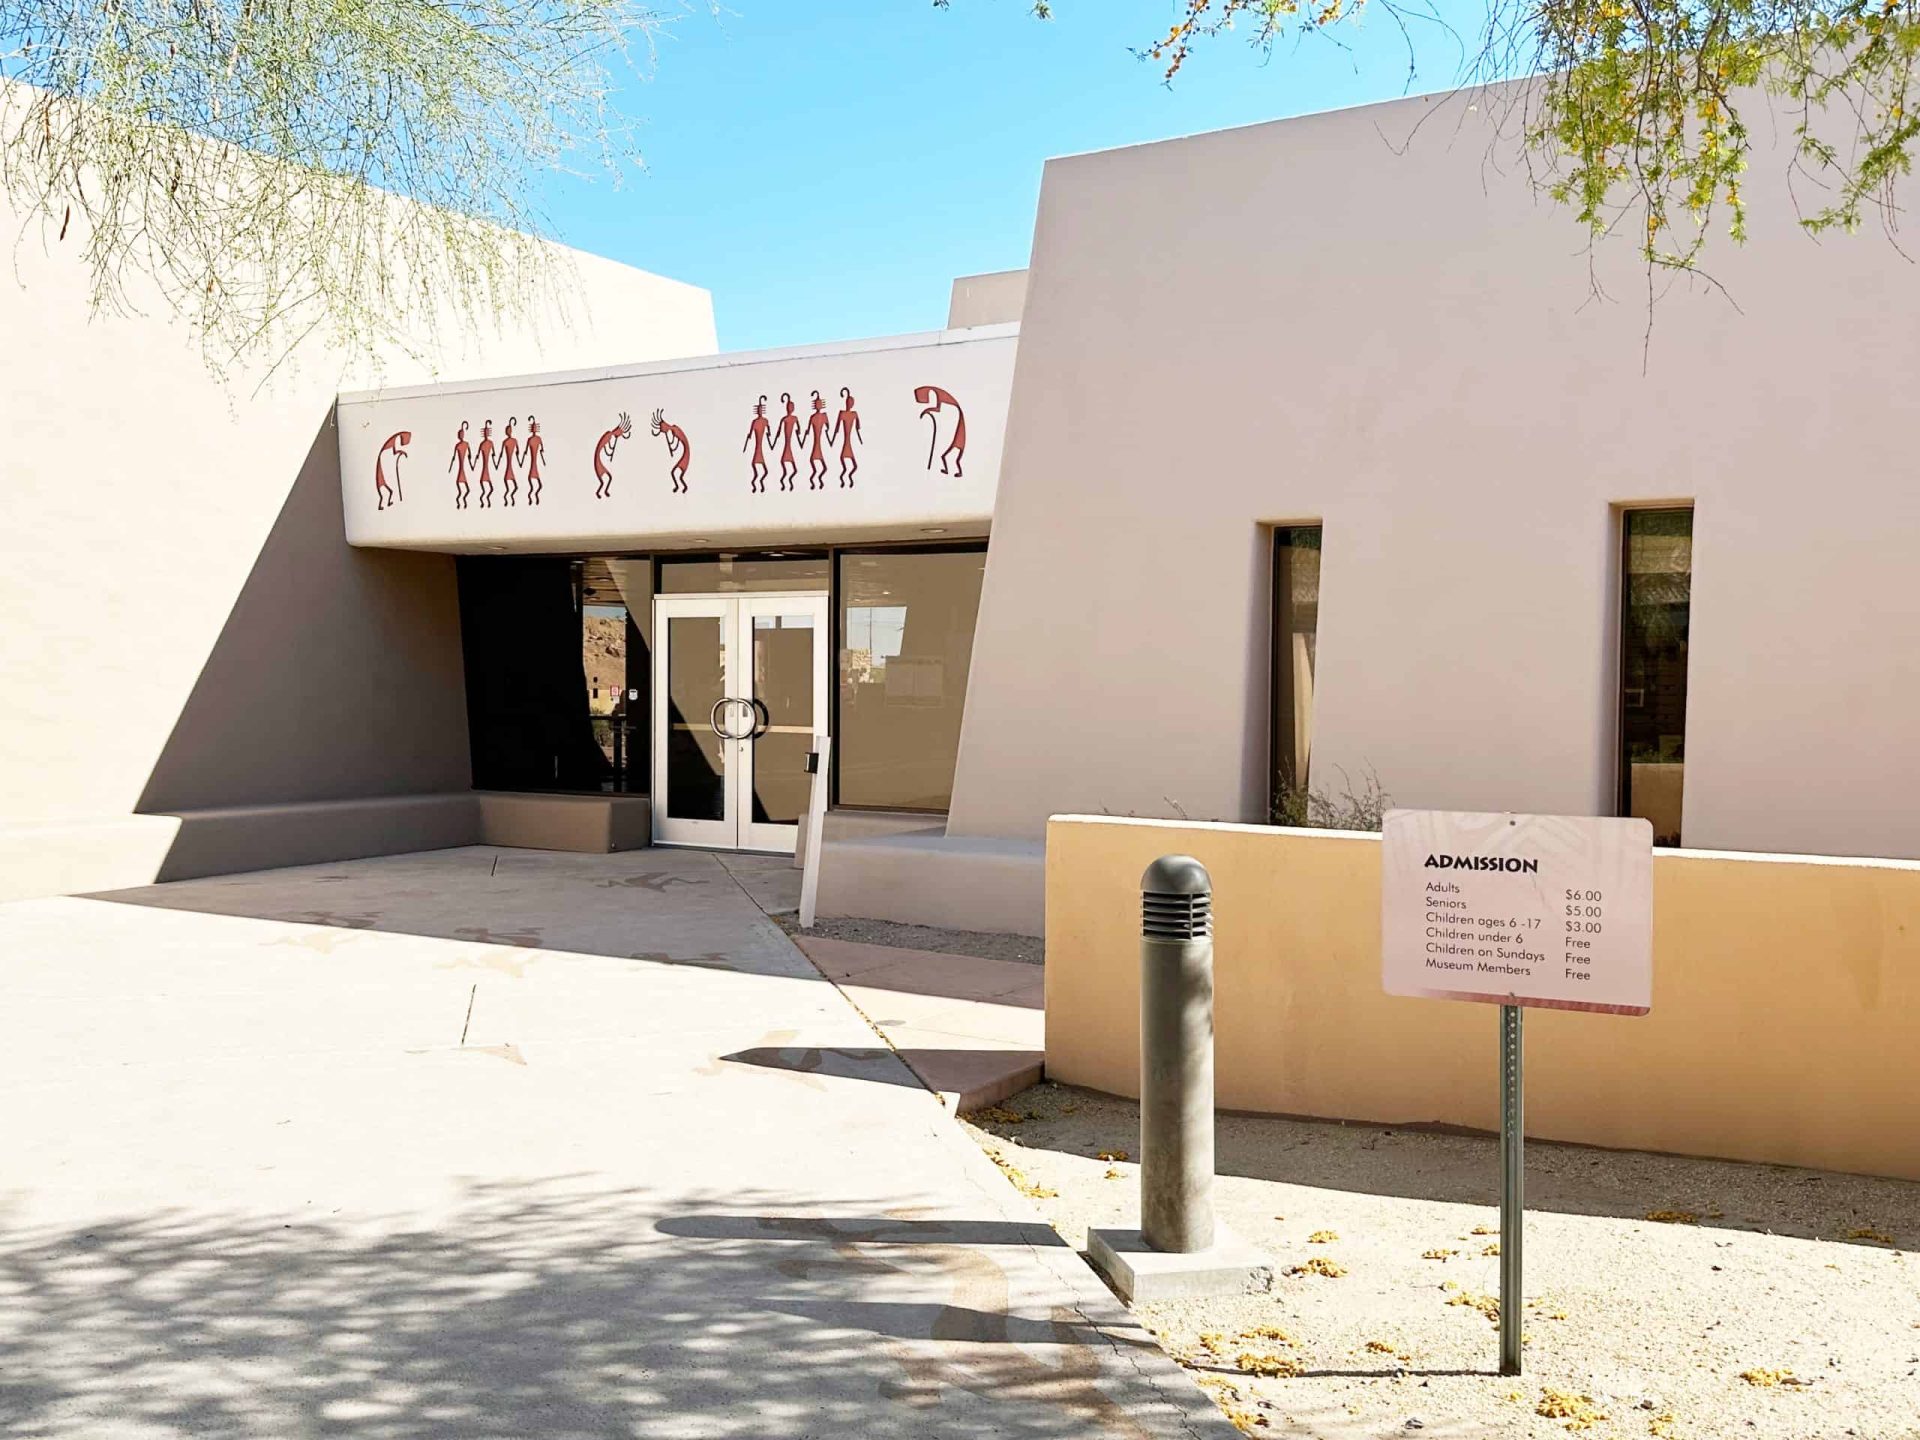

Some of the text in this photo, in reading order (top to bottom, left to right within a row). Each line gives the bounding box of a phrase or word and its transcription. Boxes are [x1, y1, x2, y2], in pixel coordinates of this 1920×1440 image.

[1424, 854, 1538, 874] ADMISSION
[1425, 882, 1602, 901] Adults $6.00
[1425, 896, 1602, 918] Seniors $5.00
[1425, 912, 1602, 934] Children ages 6 -17 $3.00
[1425, 927, 1591, 949] Children under 6 Free
[1425, 942, 1591, 965] Children on Sundays Free
[1425, 958, 1591, 981] Museum Members Free
